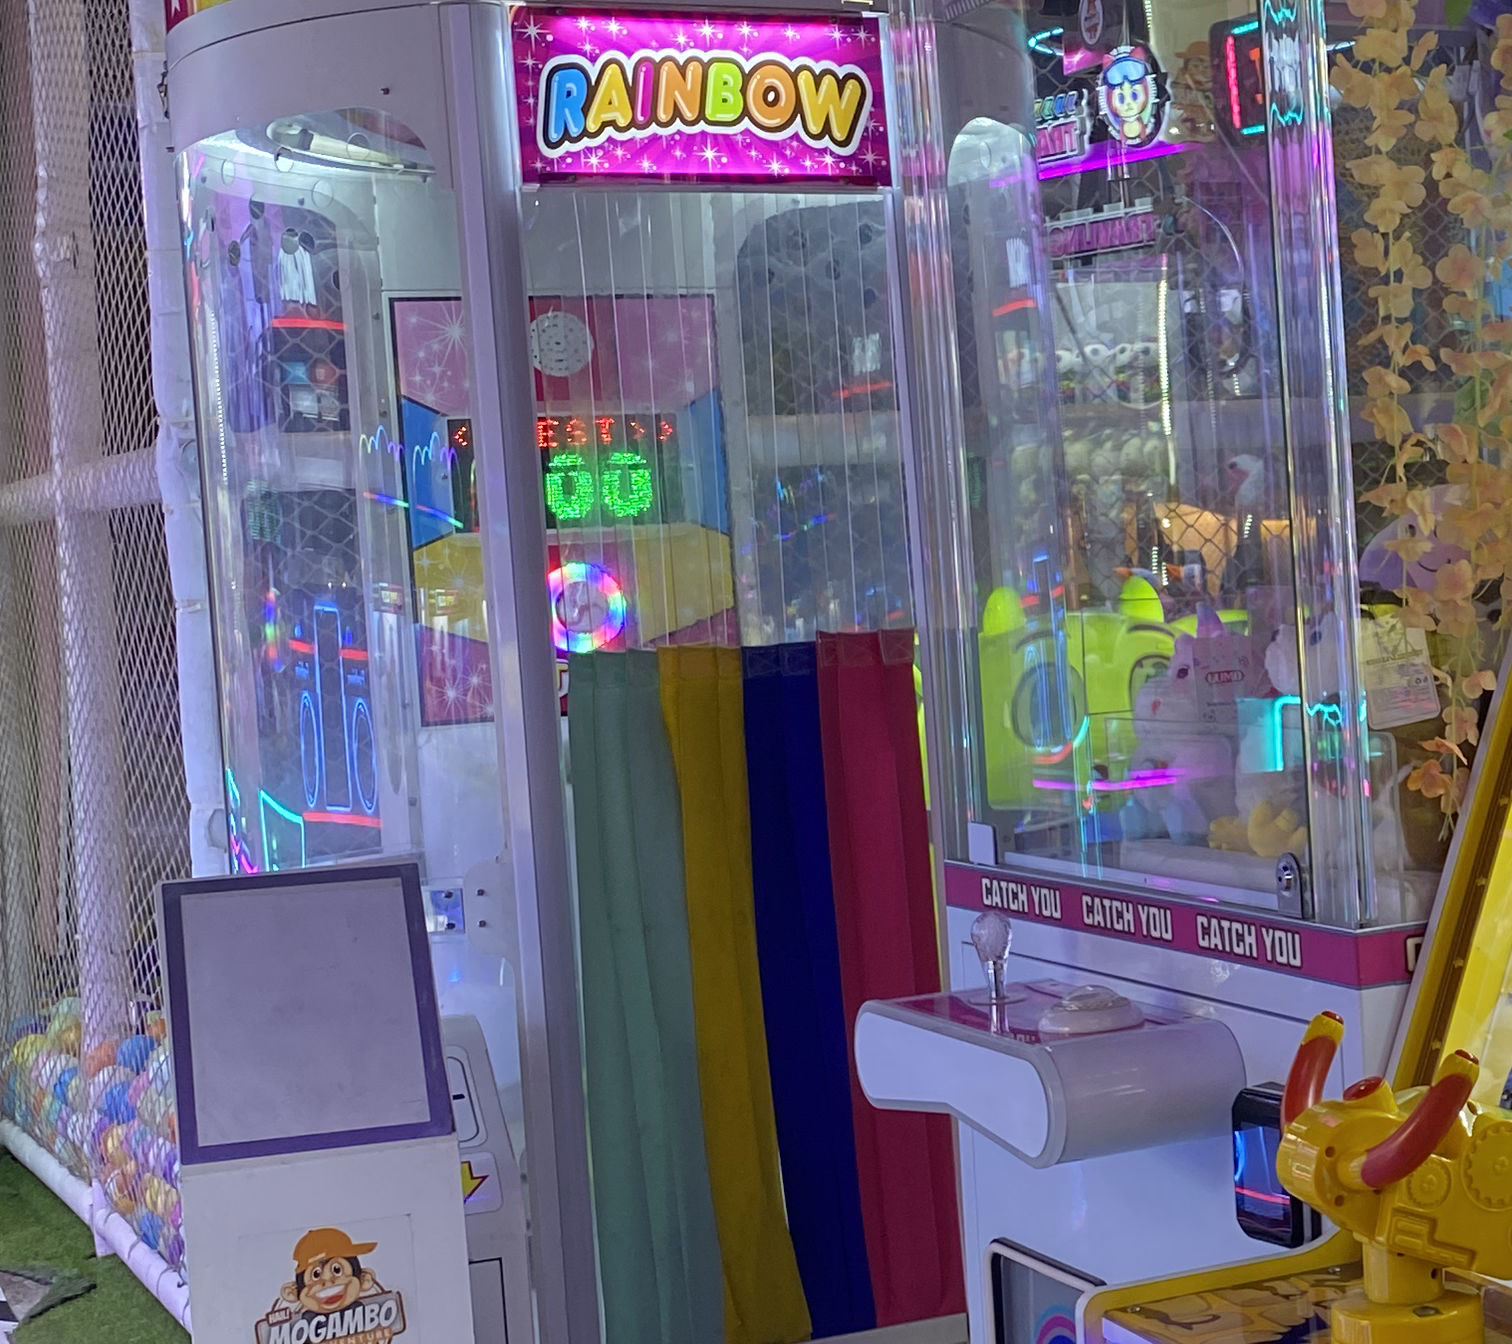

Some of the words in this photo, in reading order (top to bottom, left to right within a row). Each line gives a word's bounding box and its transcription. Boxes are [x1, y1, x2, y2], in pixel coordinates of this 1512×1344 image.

[541, 56, 868, 150] RAINBOW
[981, 877, 1029, 914] CATCH
[1030, 886, 1062, 919] YOU
[1081, 894, 1135, 935] CATCH
[1136, 904, 1173, 940] YOU
[1196, 913, 1258, 959] CATCH
[1261, 927, 1301, 968] YOU
